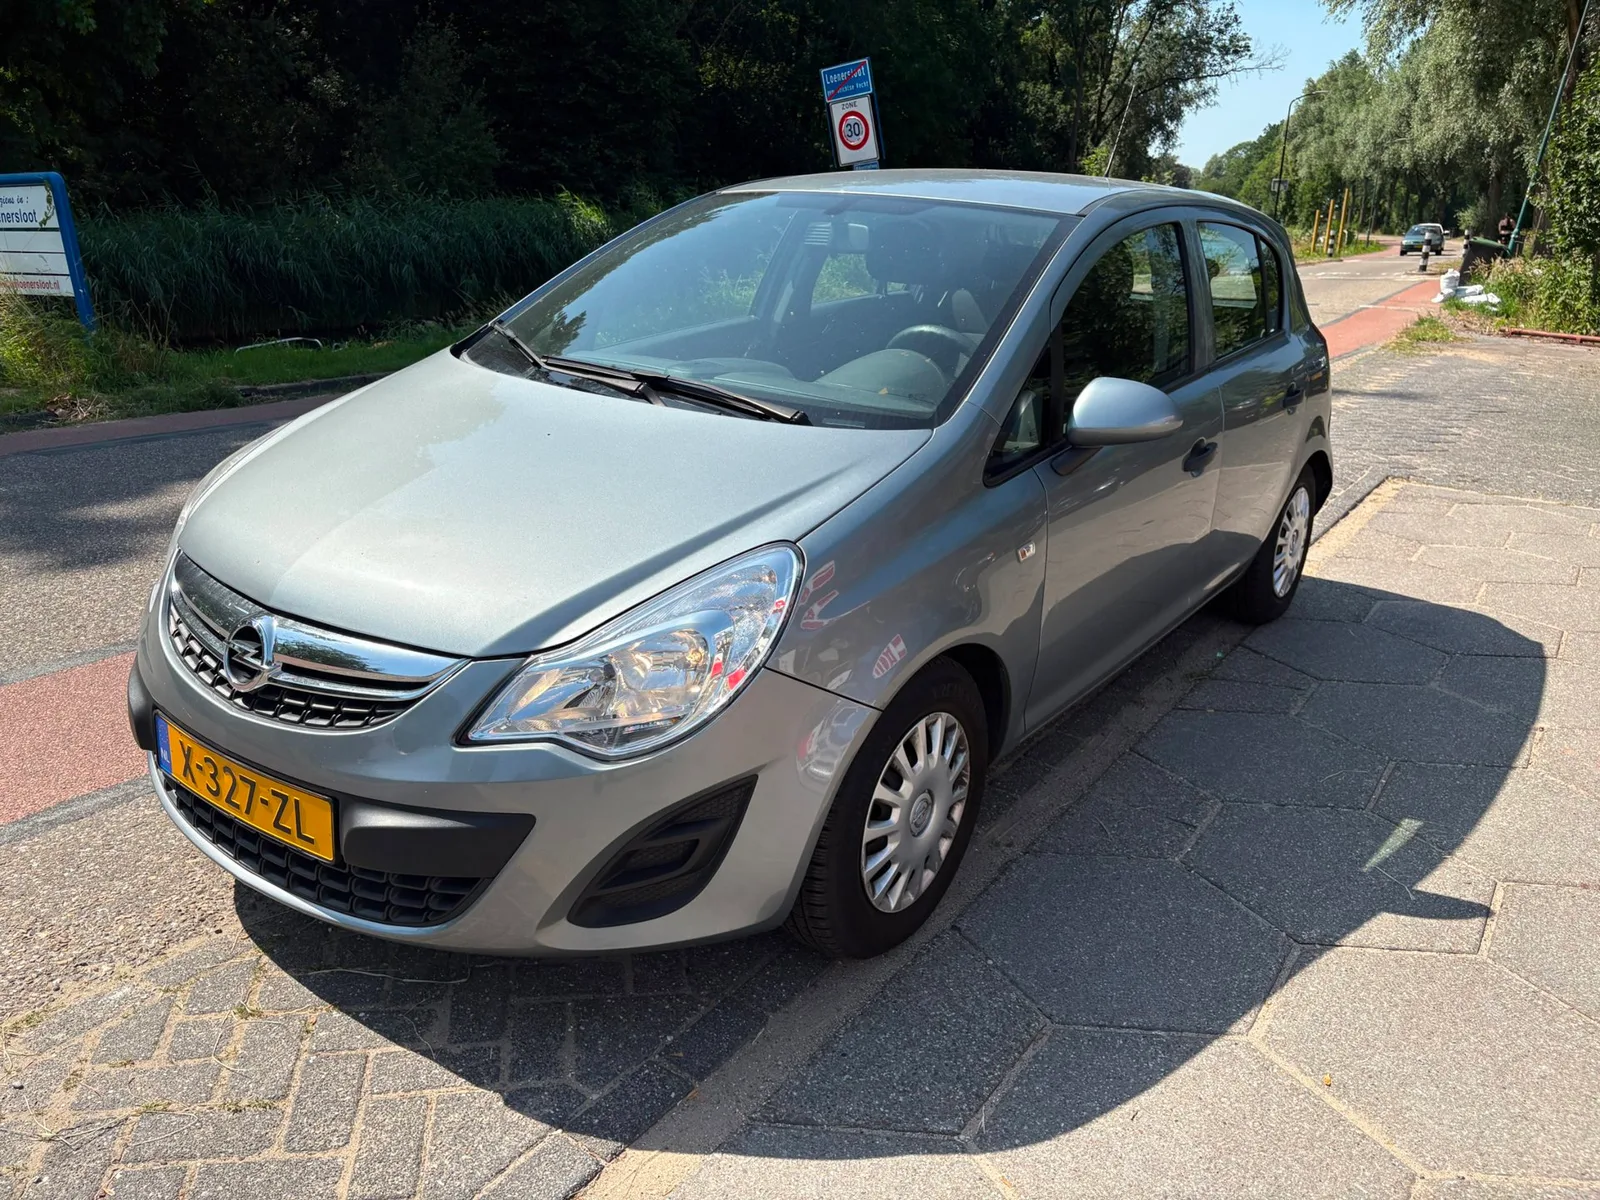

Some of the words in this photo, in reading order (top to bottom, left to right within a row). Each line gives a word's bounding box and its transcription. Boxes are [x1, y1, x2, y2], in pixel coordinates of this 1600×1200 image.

[841, 101, 858, 110] ZONE
[846, 122, 861, 138] 30
[0, 209, 38, 223] nersloot
[160, 747, 171, 764] NL
[179, 739, 315, 845] X-327-ZL
